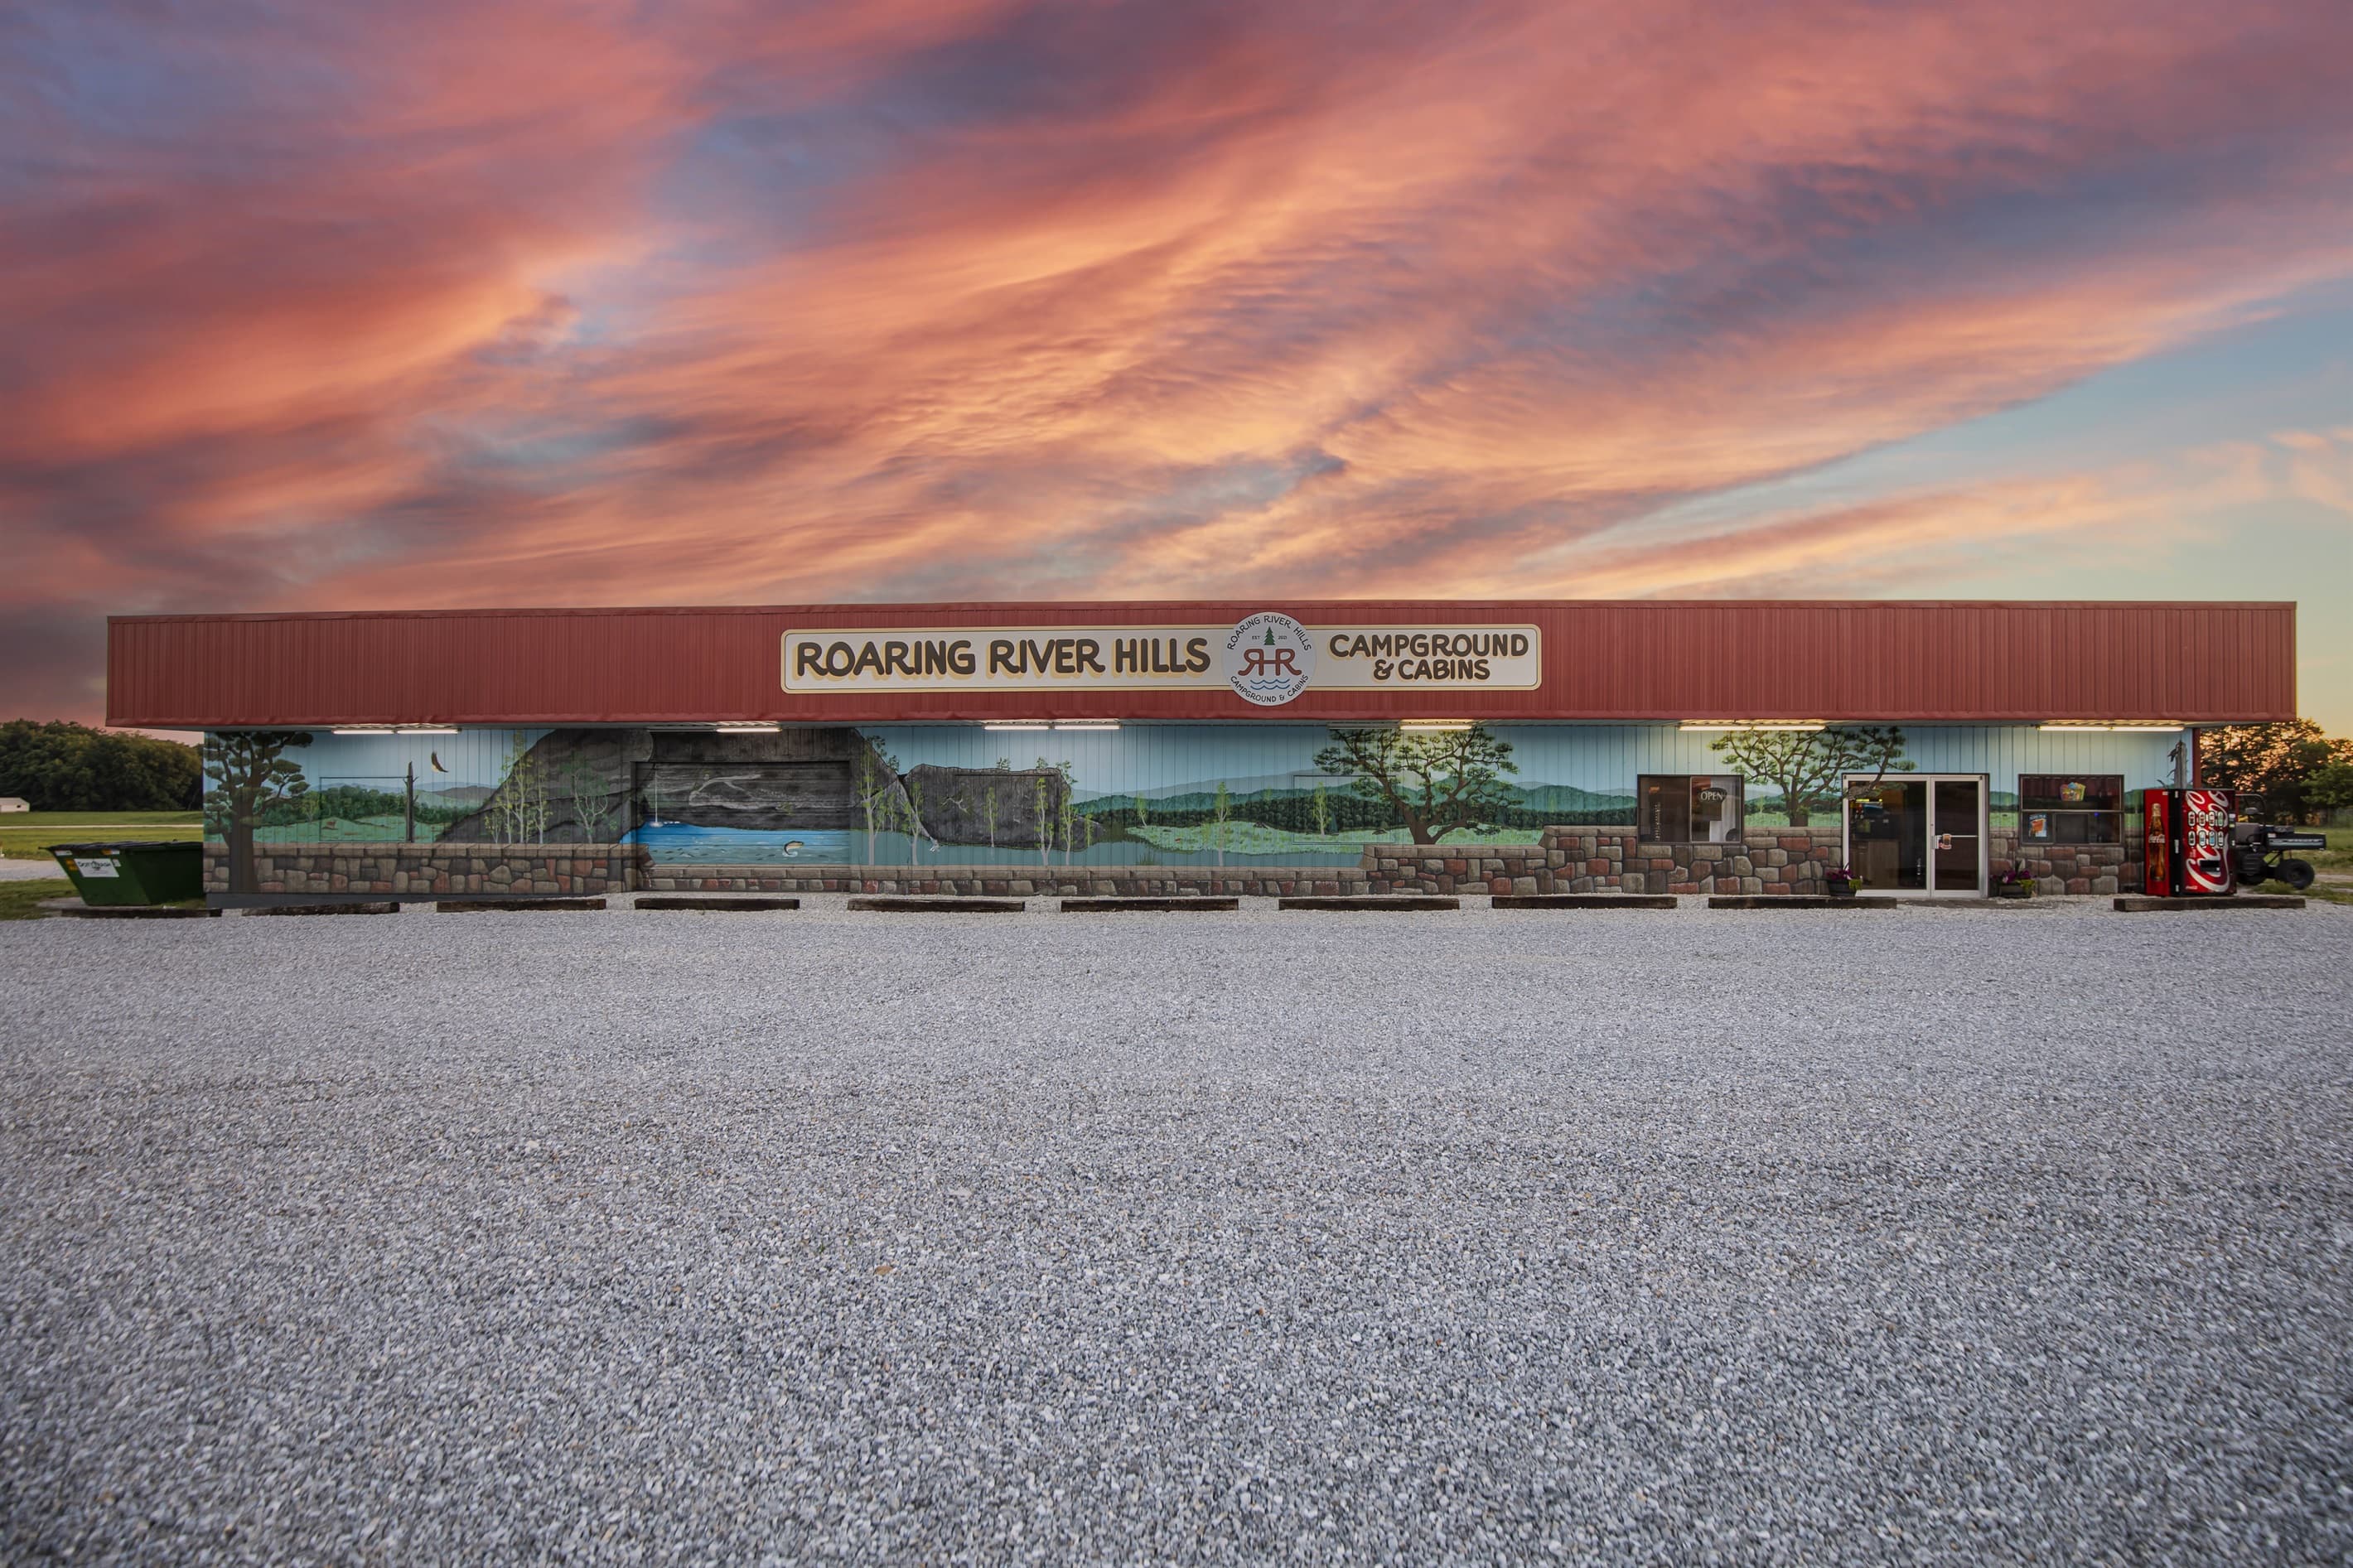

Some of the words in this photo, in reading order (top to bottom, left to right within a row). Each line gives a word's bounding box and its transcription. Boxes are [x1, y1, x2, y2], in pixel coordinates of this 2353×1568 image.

[1227, 617, 1261, 650] ROARING
[1264, 615, 1292, 629] RIVER
[1293, 627, 1312, 651] HILLS
[1329, 634, 1529, 657] CAMPGROUND
[796, 639, 976, 677] ROARING
[990, 638, 1105, 674] RIVER
[1115, 637, 1211, 673] HILLS
[1373, 659, 1394, 680] &
[1399, 659, 1491, 680] CABINS
[1230, 675, 1277, 702] CAMPGROUND
[1288, 674, 1309, 697] CABINS
[1700, 790, 1723, 801] OPEN
